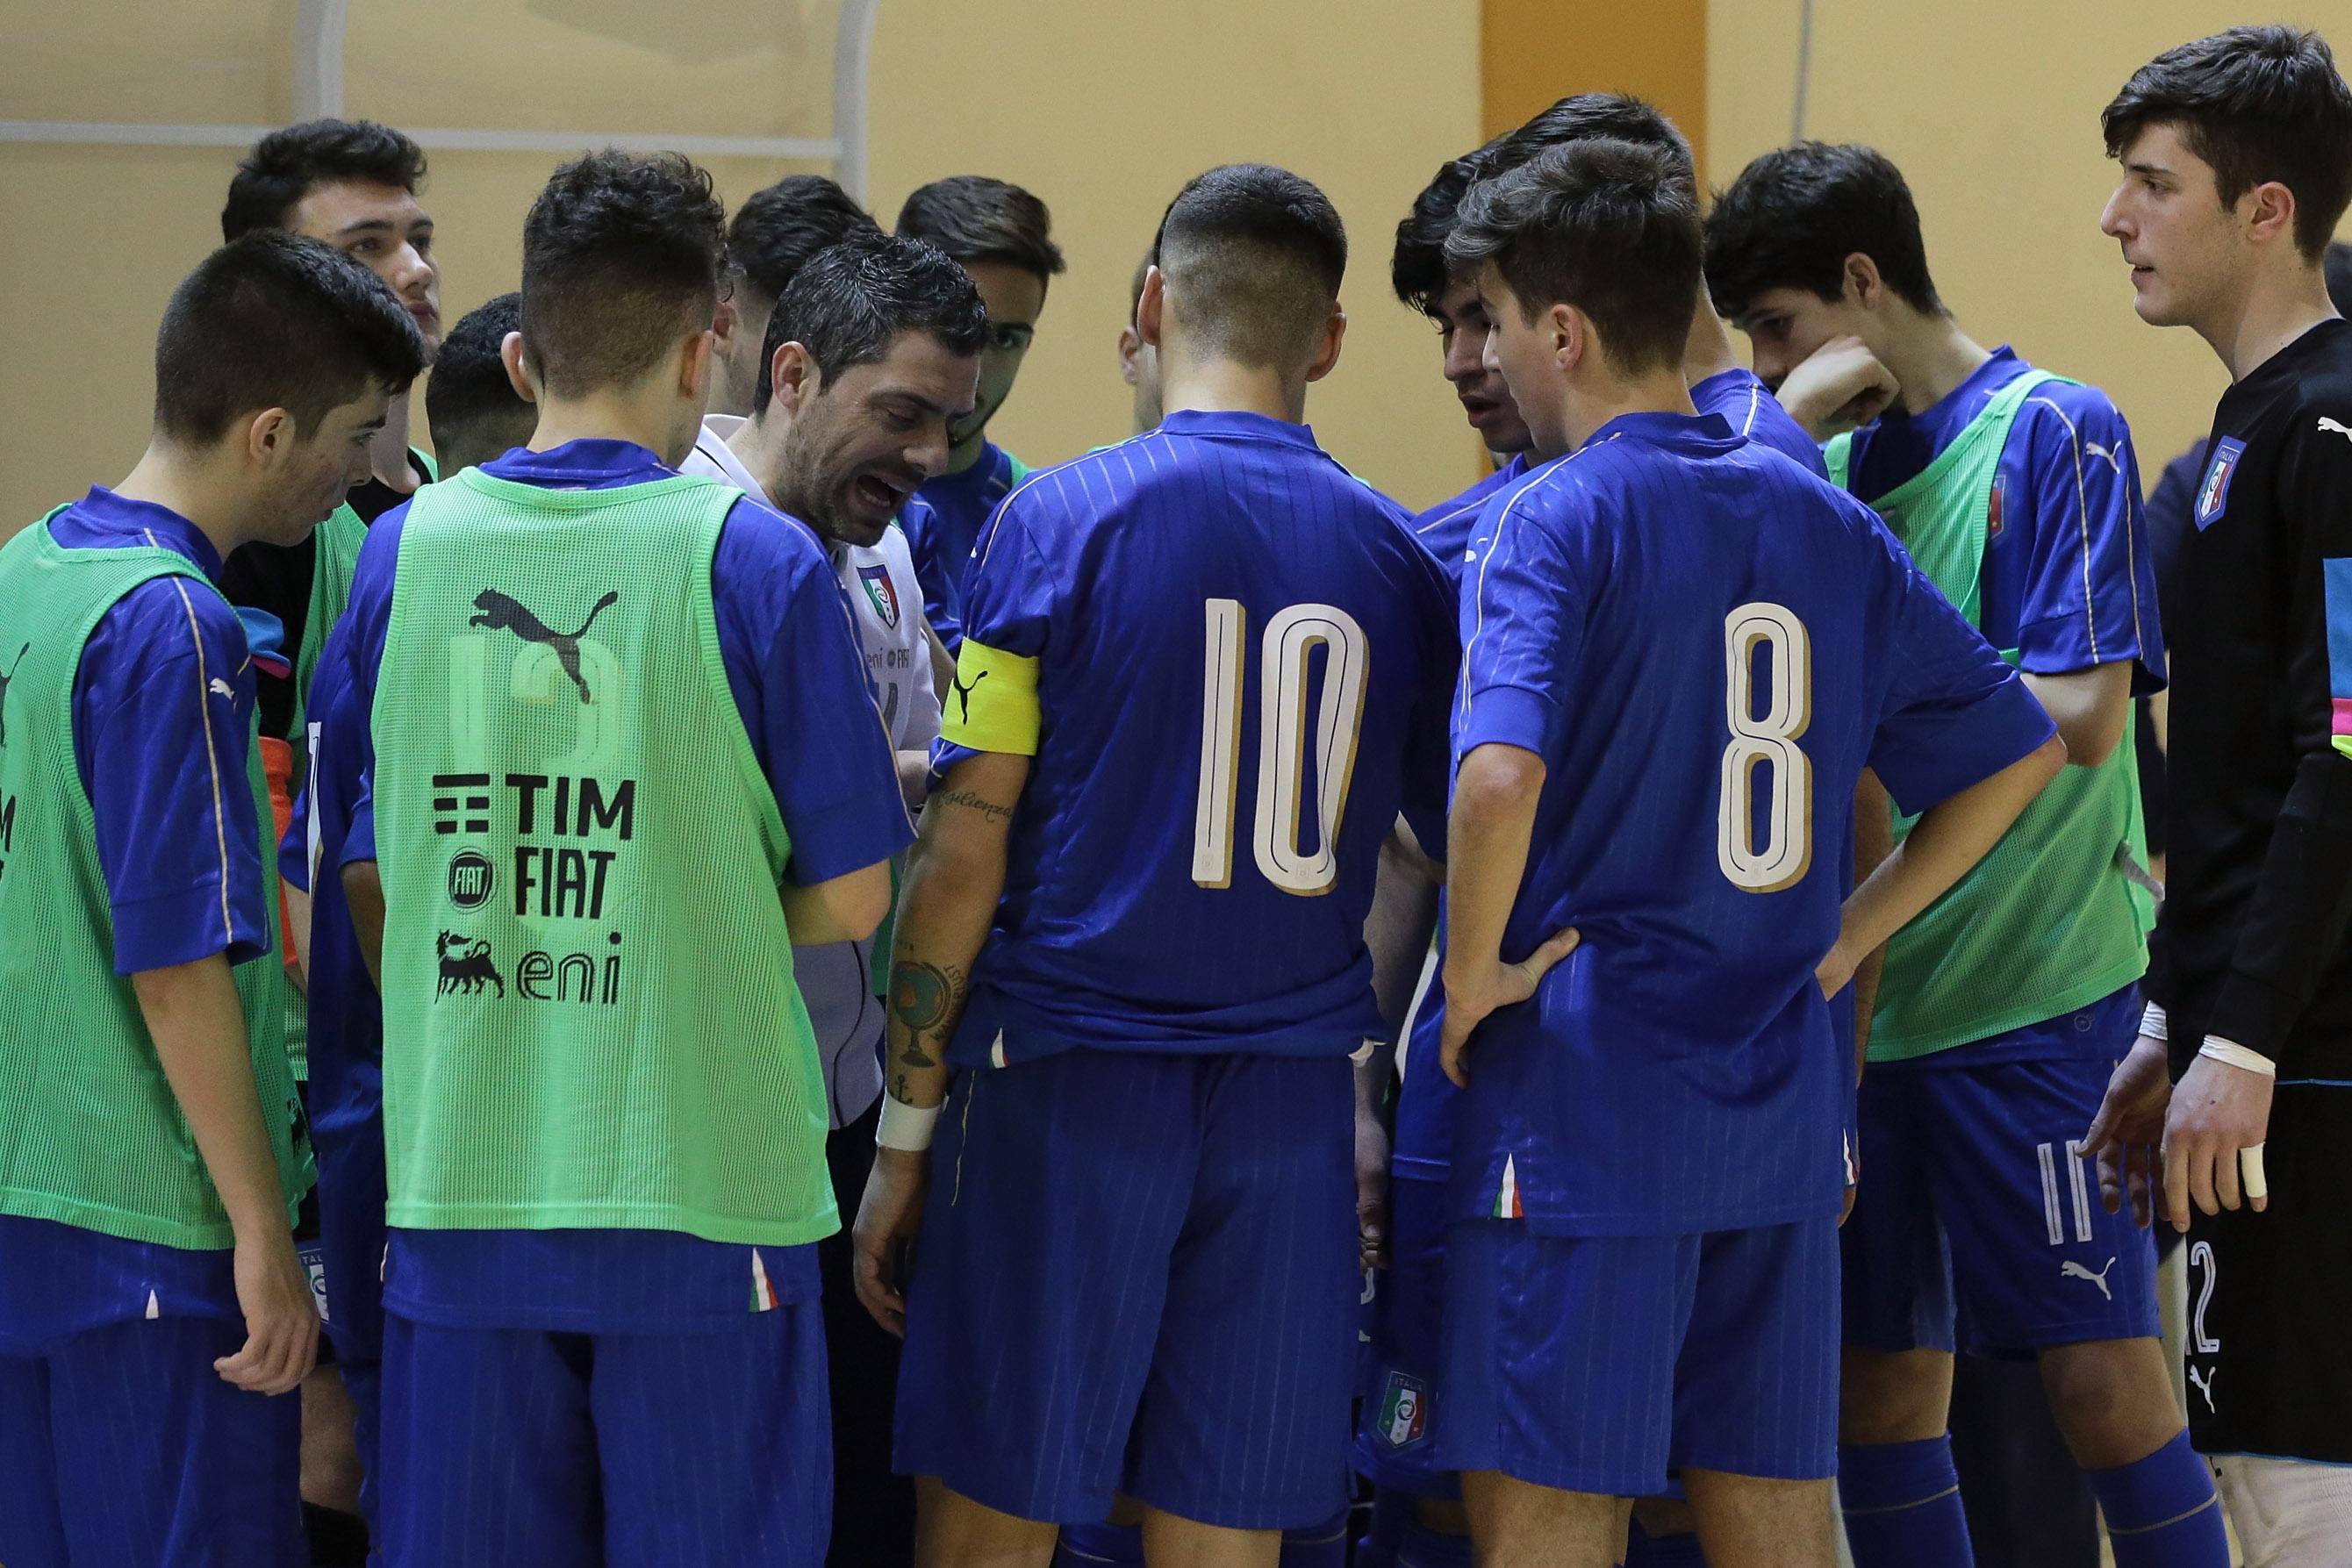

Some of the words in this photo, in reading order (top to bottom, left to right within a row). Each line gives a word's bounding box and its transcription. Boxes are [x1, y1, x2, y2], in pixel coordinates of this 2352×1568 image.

[1192, 598, 1370, 897] 10
[1717, 602, 1813, 894] 8
[505, 773, 636, 841] TIM
[454, 867, 486, 897] FIAT
[515, 846, 617, 920] FIAT
[516, 931, 623, 1006] eni
[2037, 1140, 2093, 1246] 11
[2185, 1240, 2220, 1356] 2
